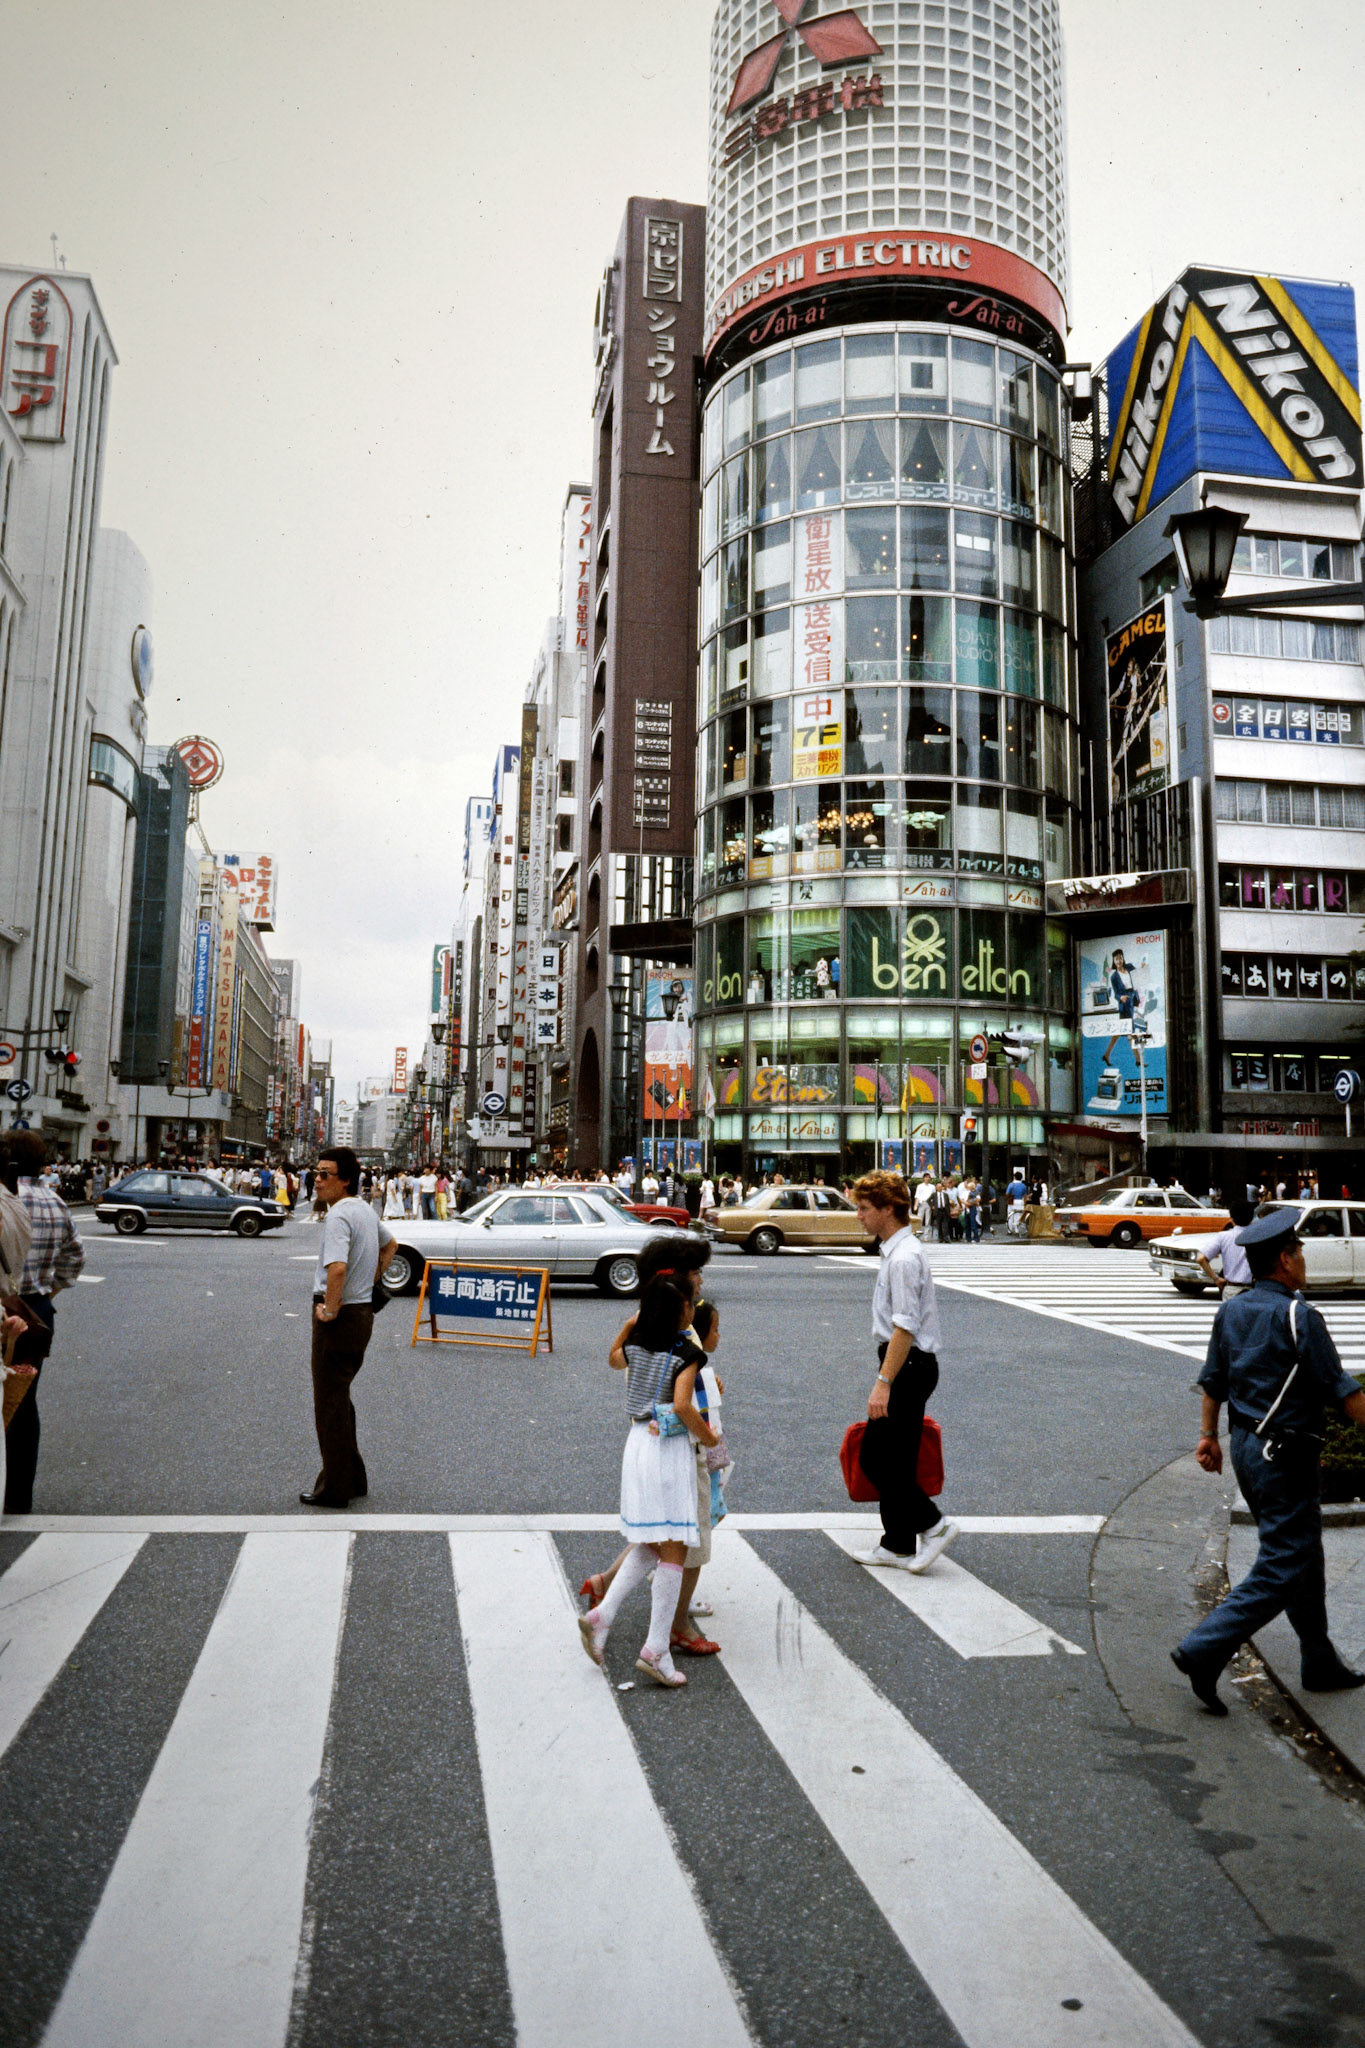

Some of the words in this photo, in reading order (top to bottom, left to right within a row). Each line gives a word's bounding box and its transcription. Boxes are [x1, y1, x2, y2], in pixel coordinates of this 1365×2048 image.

[648, 223, 678, 296] 京セラ
[703, 254, 805, 352] TSUBISHI
[815, 239, 972, 274] ELECTRIC
[749, 298, 828, 344] San-ai
[947, 297, 1026, 335] San-ai
[646, 307, 676, 456] ショウルーム
[1198, 283, 1356, 480] Nikon
[1112, 283, 1189, 526] Nikon
[1108, 613, 1166, 667] CAMEL
[637, 721, 644, 729] 6
[638, 703, 644, 711] 7
[1236, 705, 1310, 728] 全日空
[796, 723, 839, 747] 7F
[637, 756, 643, 764] 4
[253, 855, 273, 919] キャラメル
[1136, 934, 1161, 945] RICOH
[495, 889, 513, 1069] ワシントン店
[1247, 964, 1347, 989] あけぼの
[538, 955, 557, 1038] 日本堂
[751, 1067, 832, 1102] Etam
[792, 1121, 836, 1136] San-ai
[438, 1275, 536, 1305] 車両通行止
